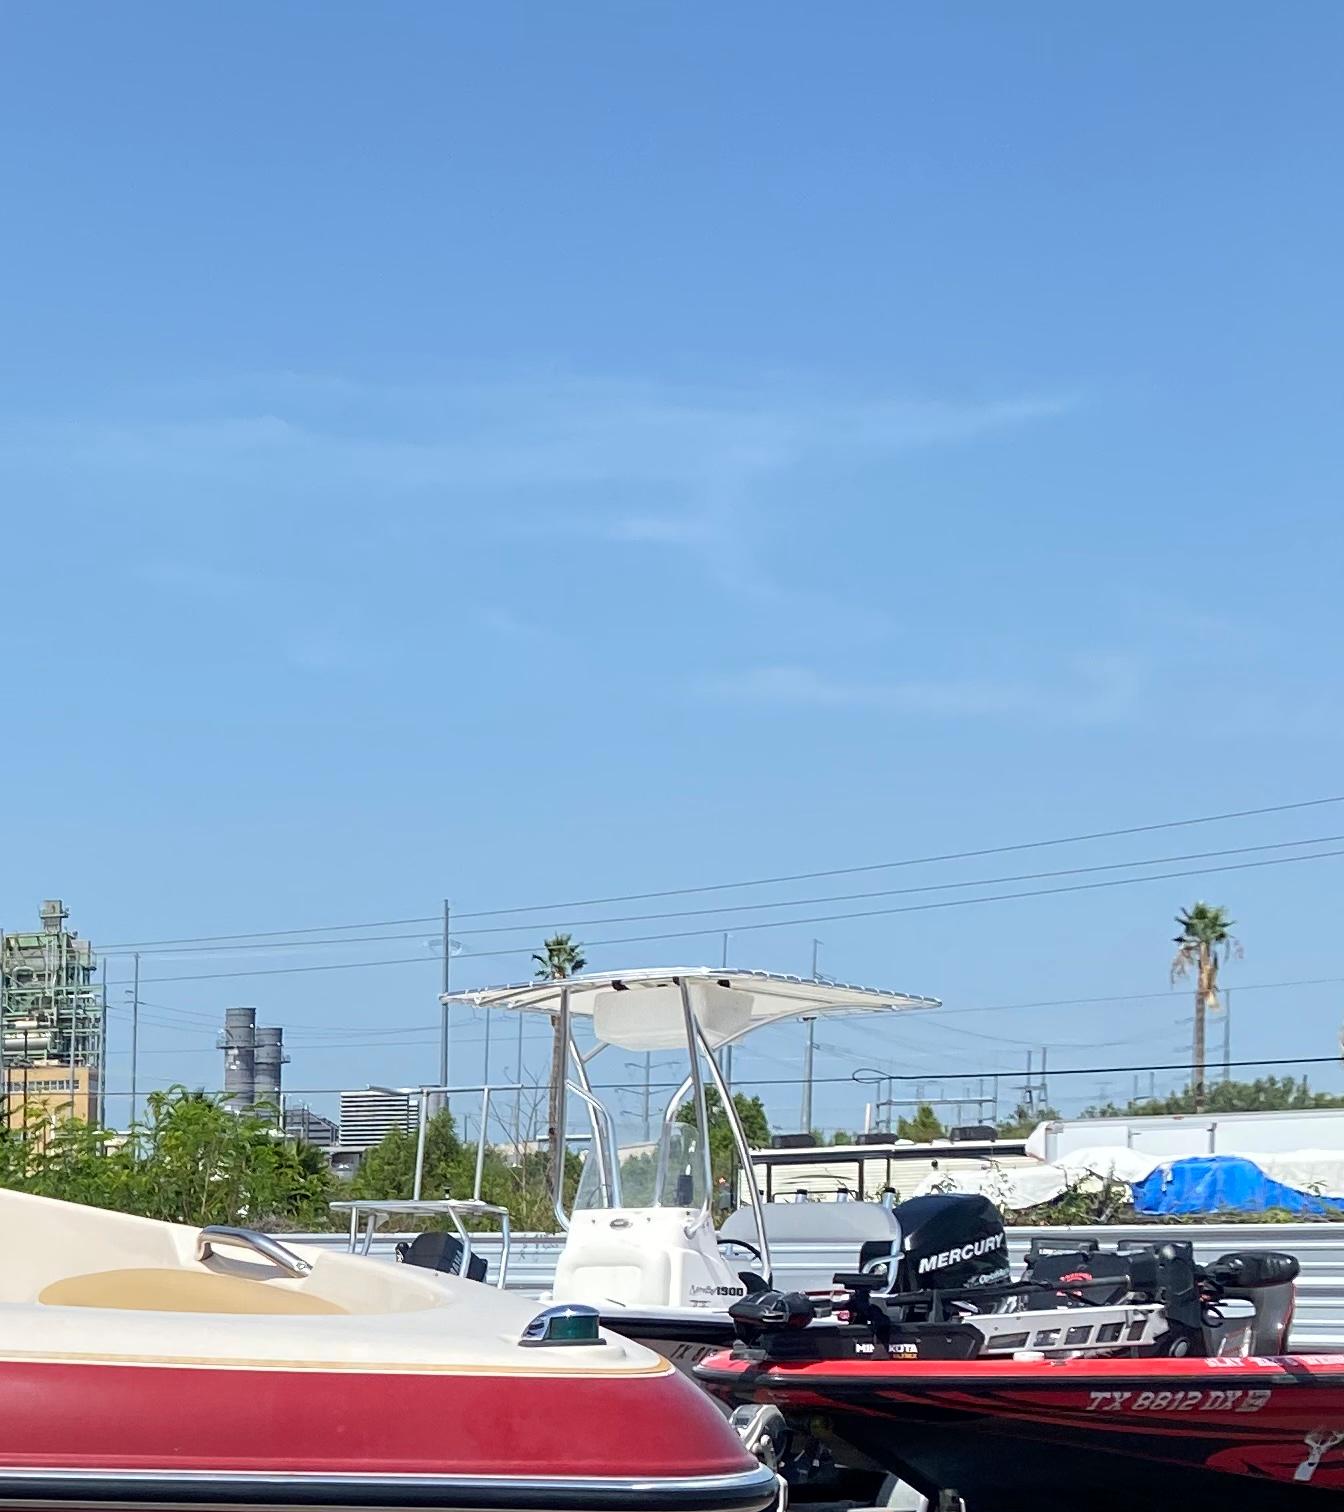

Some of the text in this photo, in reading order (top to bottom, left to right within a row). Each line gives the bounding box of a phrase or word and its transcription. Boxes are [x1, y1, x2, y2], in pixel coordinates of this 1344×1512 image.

[918, 1232, 1004, 1274] MERCURY
[717, 1286, 744, 1297] 1900
[1086, 1391, 1131, 1411] TX
[1131, 1391, 1202, 1411] 8812
